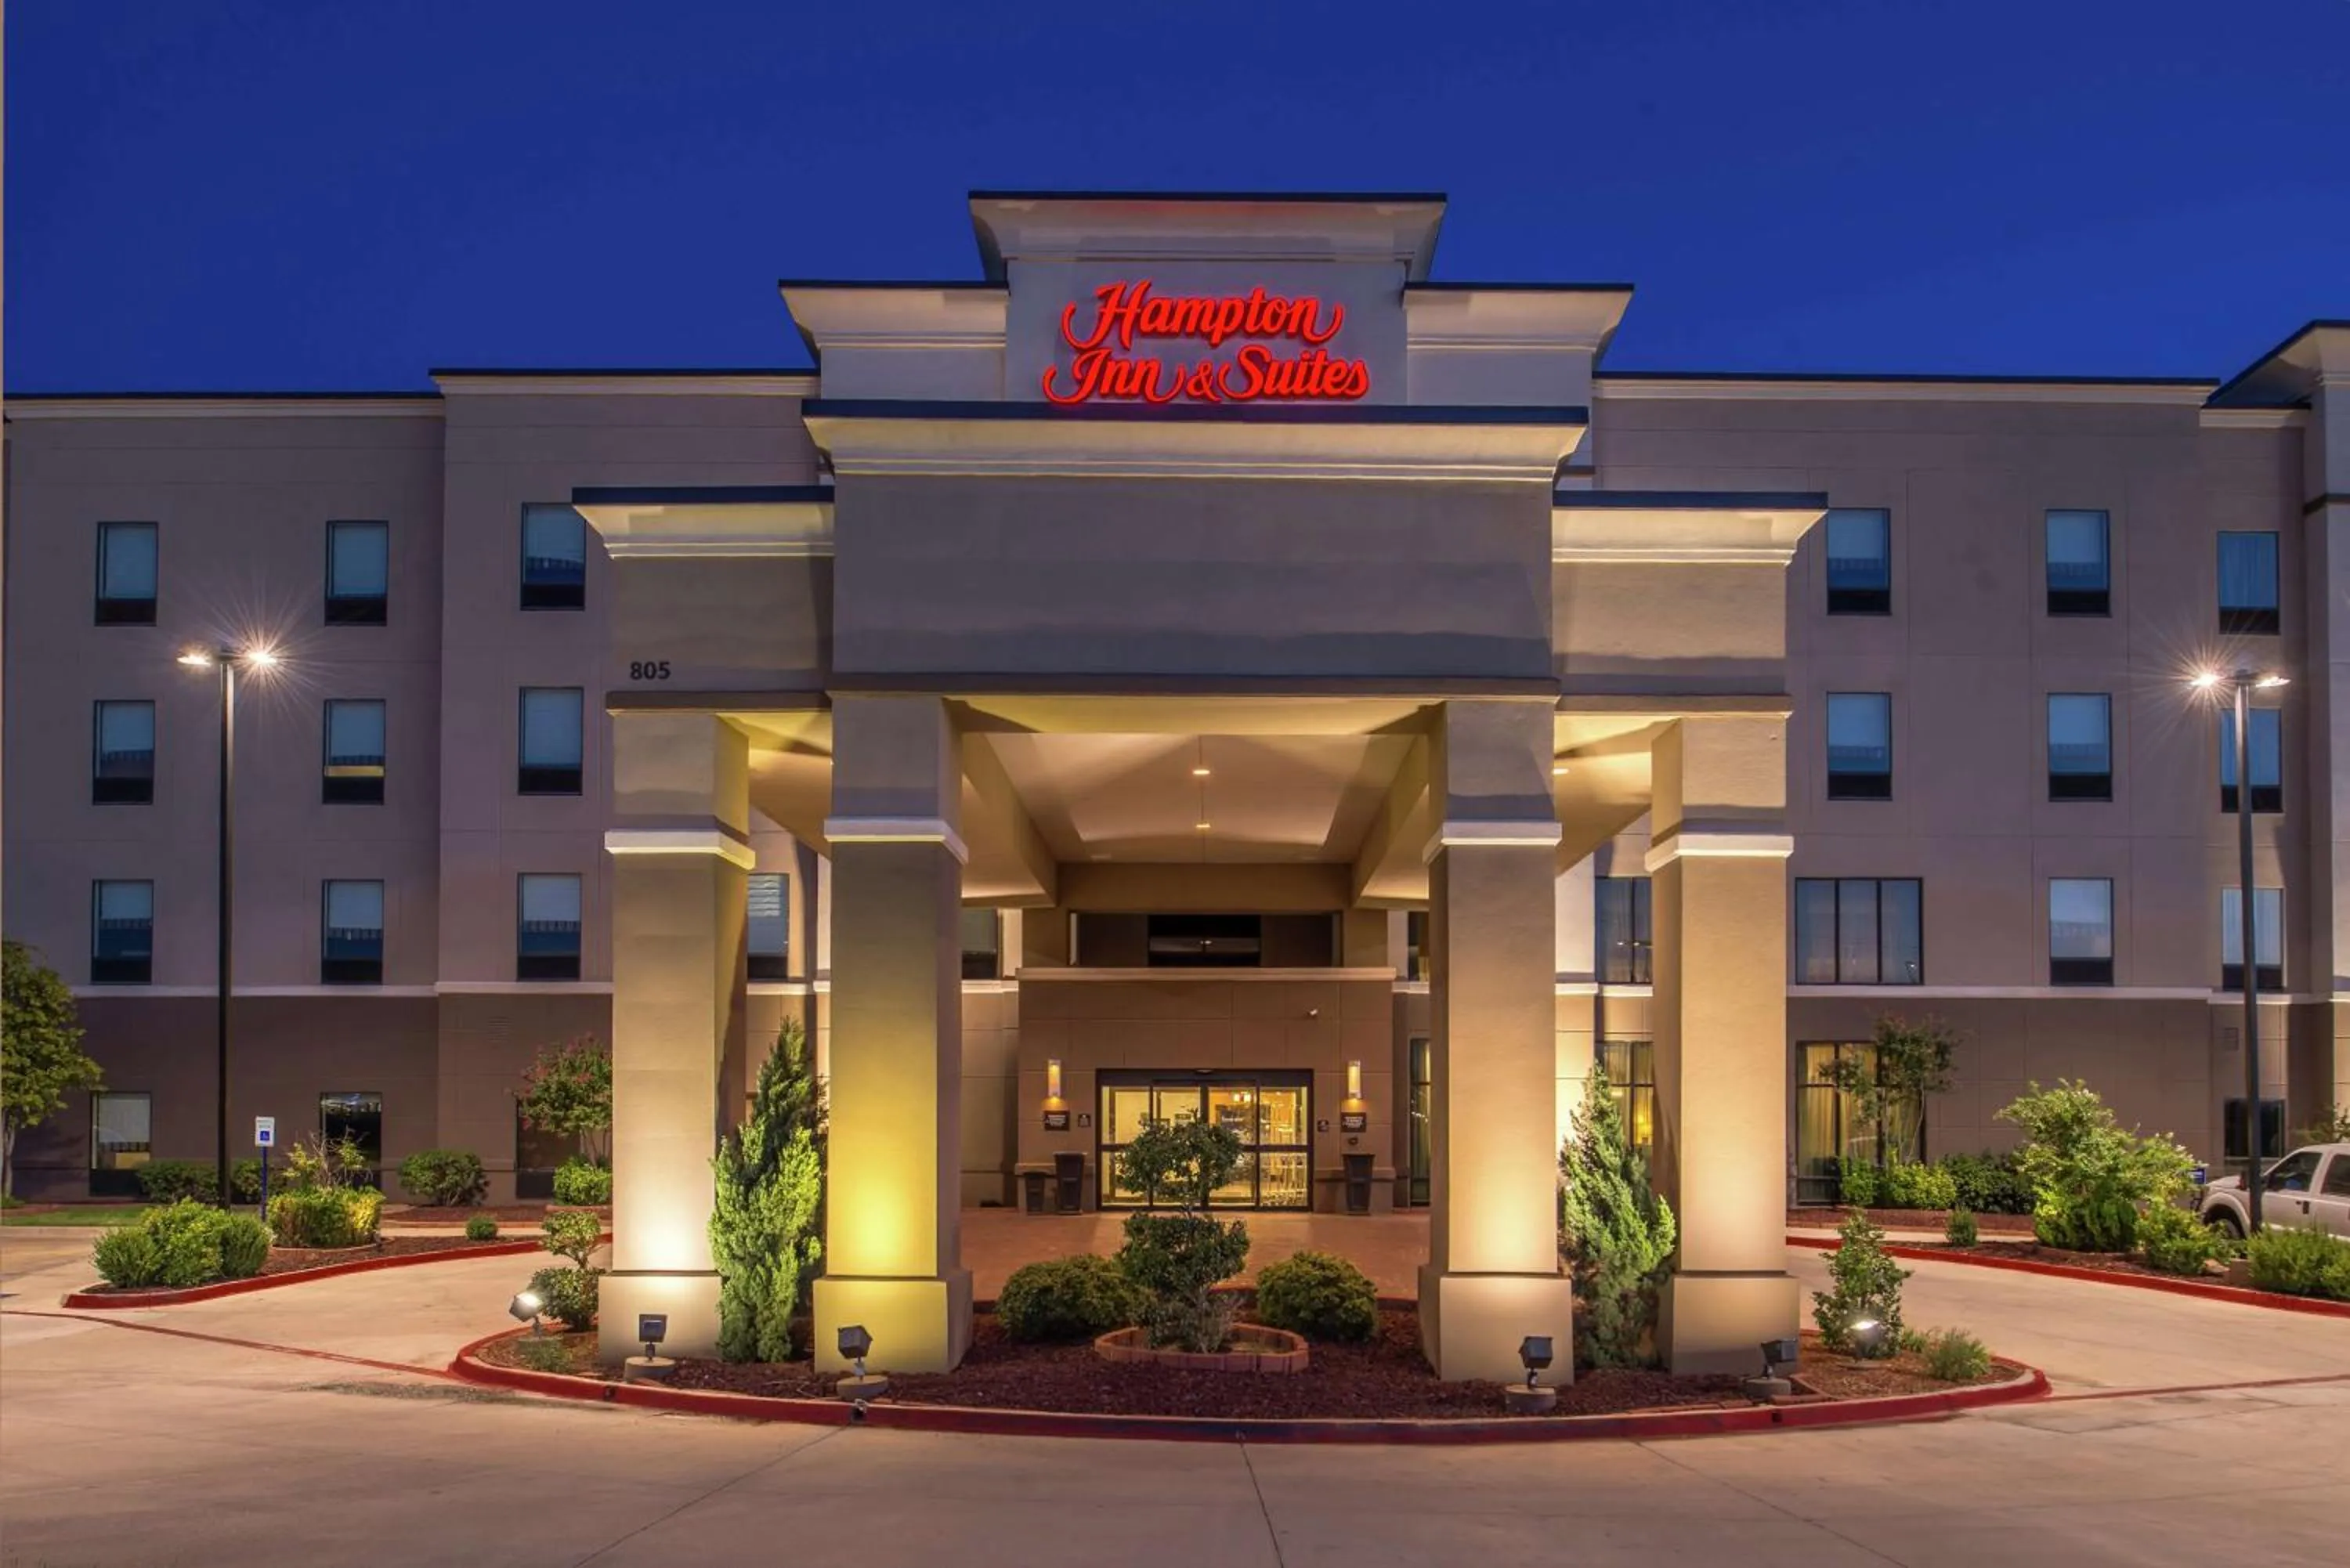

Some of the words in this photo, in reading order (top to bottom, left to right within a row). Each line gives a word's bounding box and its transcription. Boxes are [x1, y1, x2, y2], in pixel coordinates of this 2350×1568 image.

[1061, 280, 1345, 350] Hampton
[1043, 347, 1186, 404] Inn
[1186, 360, 1222, 402] &
[1217, 345, 1370, 400] Suites
[629, 660, 671, 681] 805
